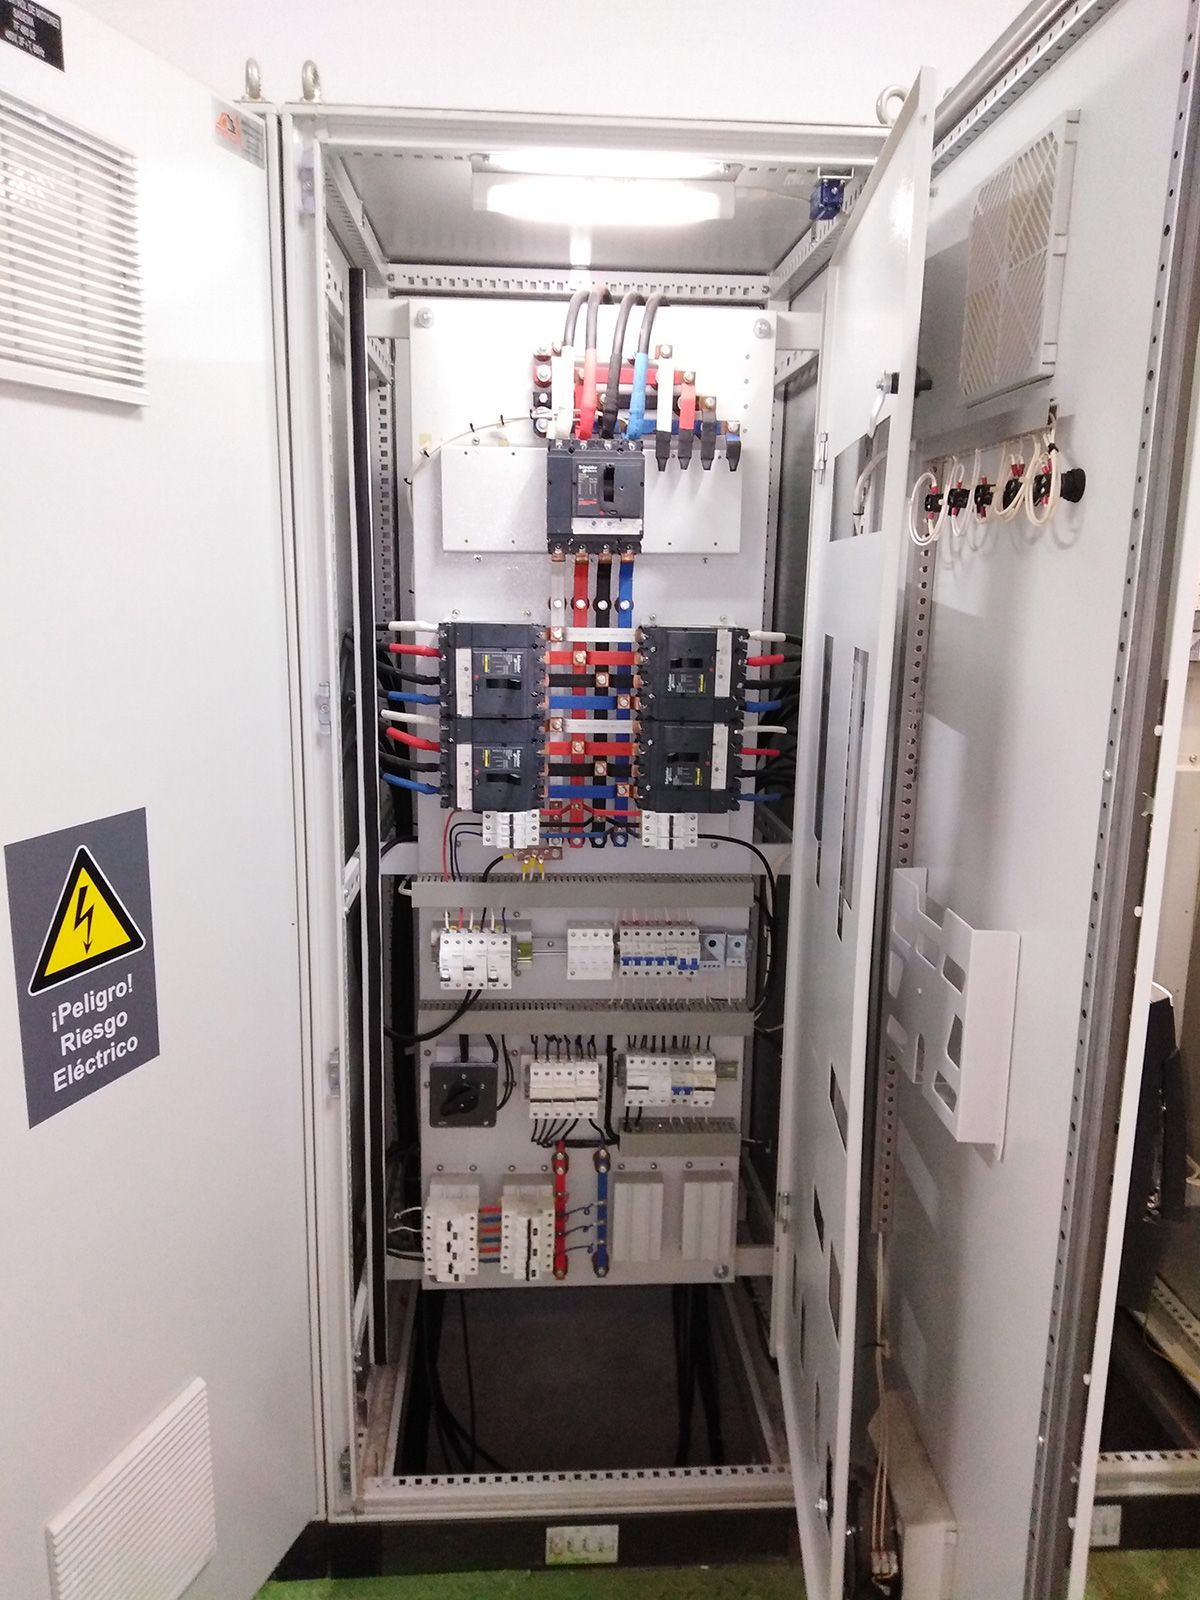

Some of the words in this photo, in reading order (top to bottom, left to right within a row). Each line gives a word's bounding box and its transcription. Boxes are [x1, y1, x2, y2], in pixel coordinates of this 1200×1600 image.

[51, 973, 133, 1033] ¡Peligro!
[60, 1011, 128, 1057] Riesgo
[53, 1036, 139, 1093] Eléctrico
